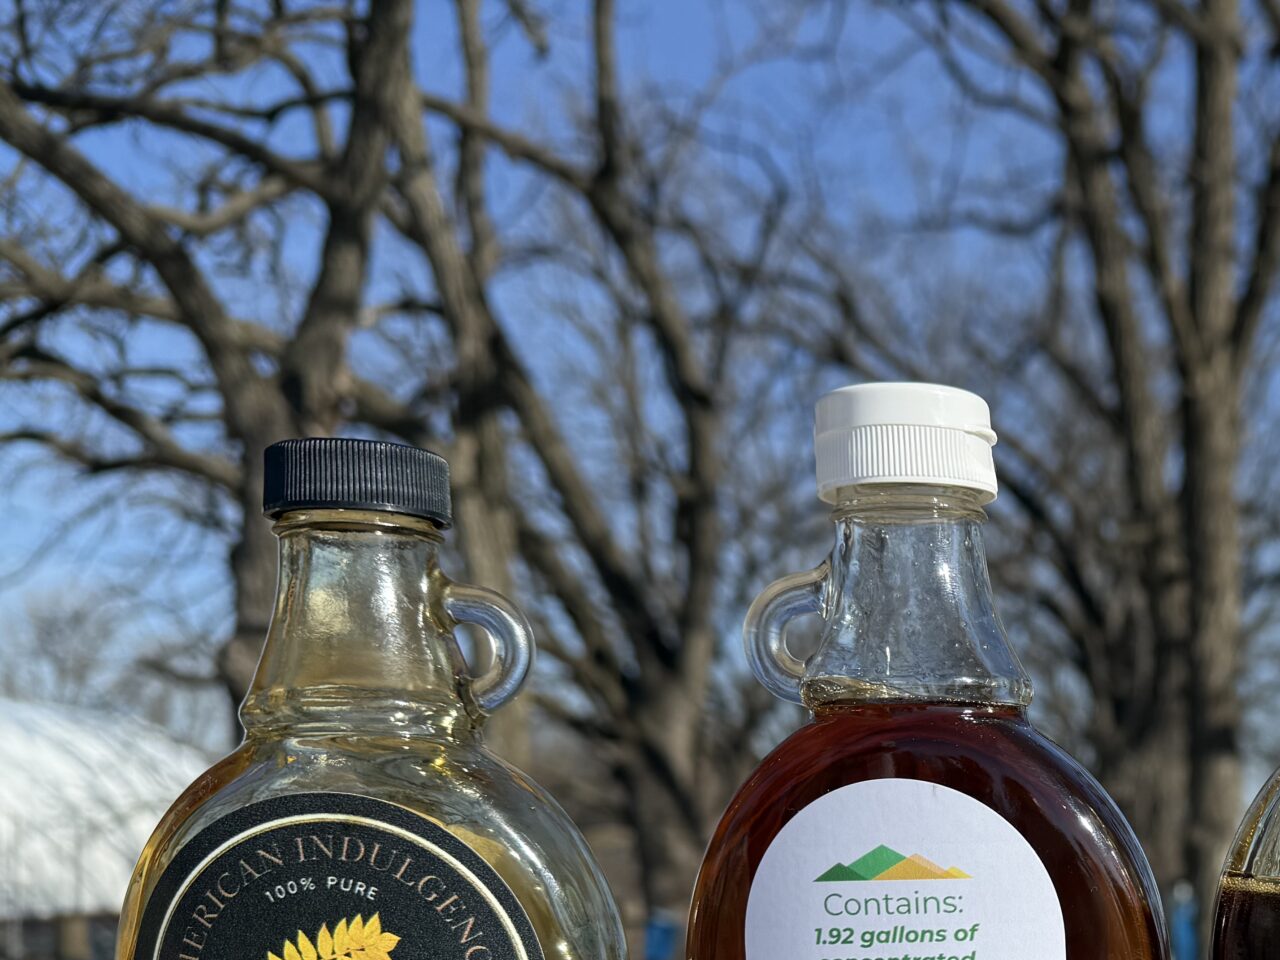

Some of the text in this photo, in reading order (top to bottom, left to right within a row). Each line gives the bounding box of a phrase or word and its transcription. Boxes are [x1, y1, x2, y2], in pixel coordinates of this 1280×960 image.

[264, 876, 378, 902] 100% PURE
[823, 890, 964, 917] Contains:
[813, 923, 979, 949] 1.92 gallons of
